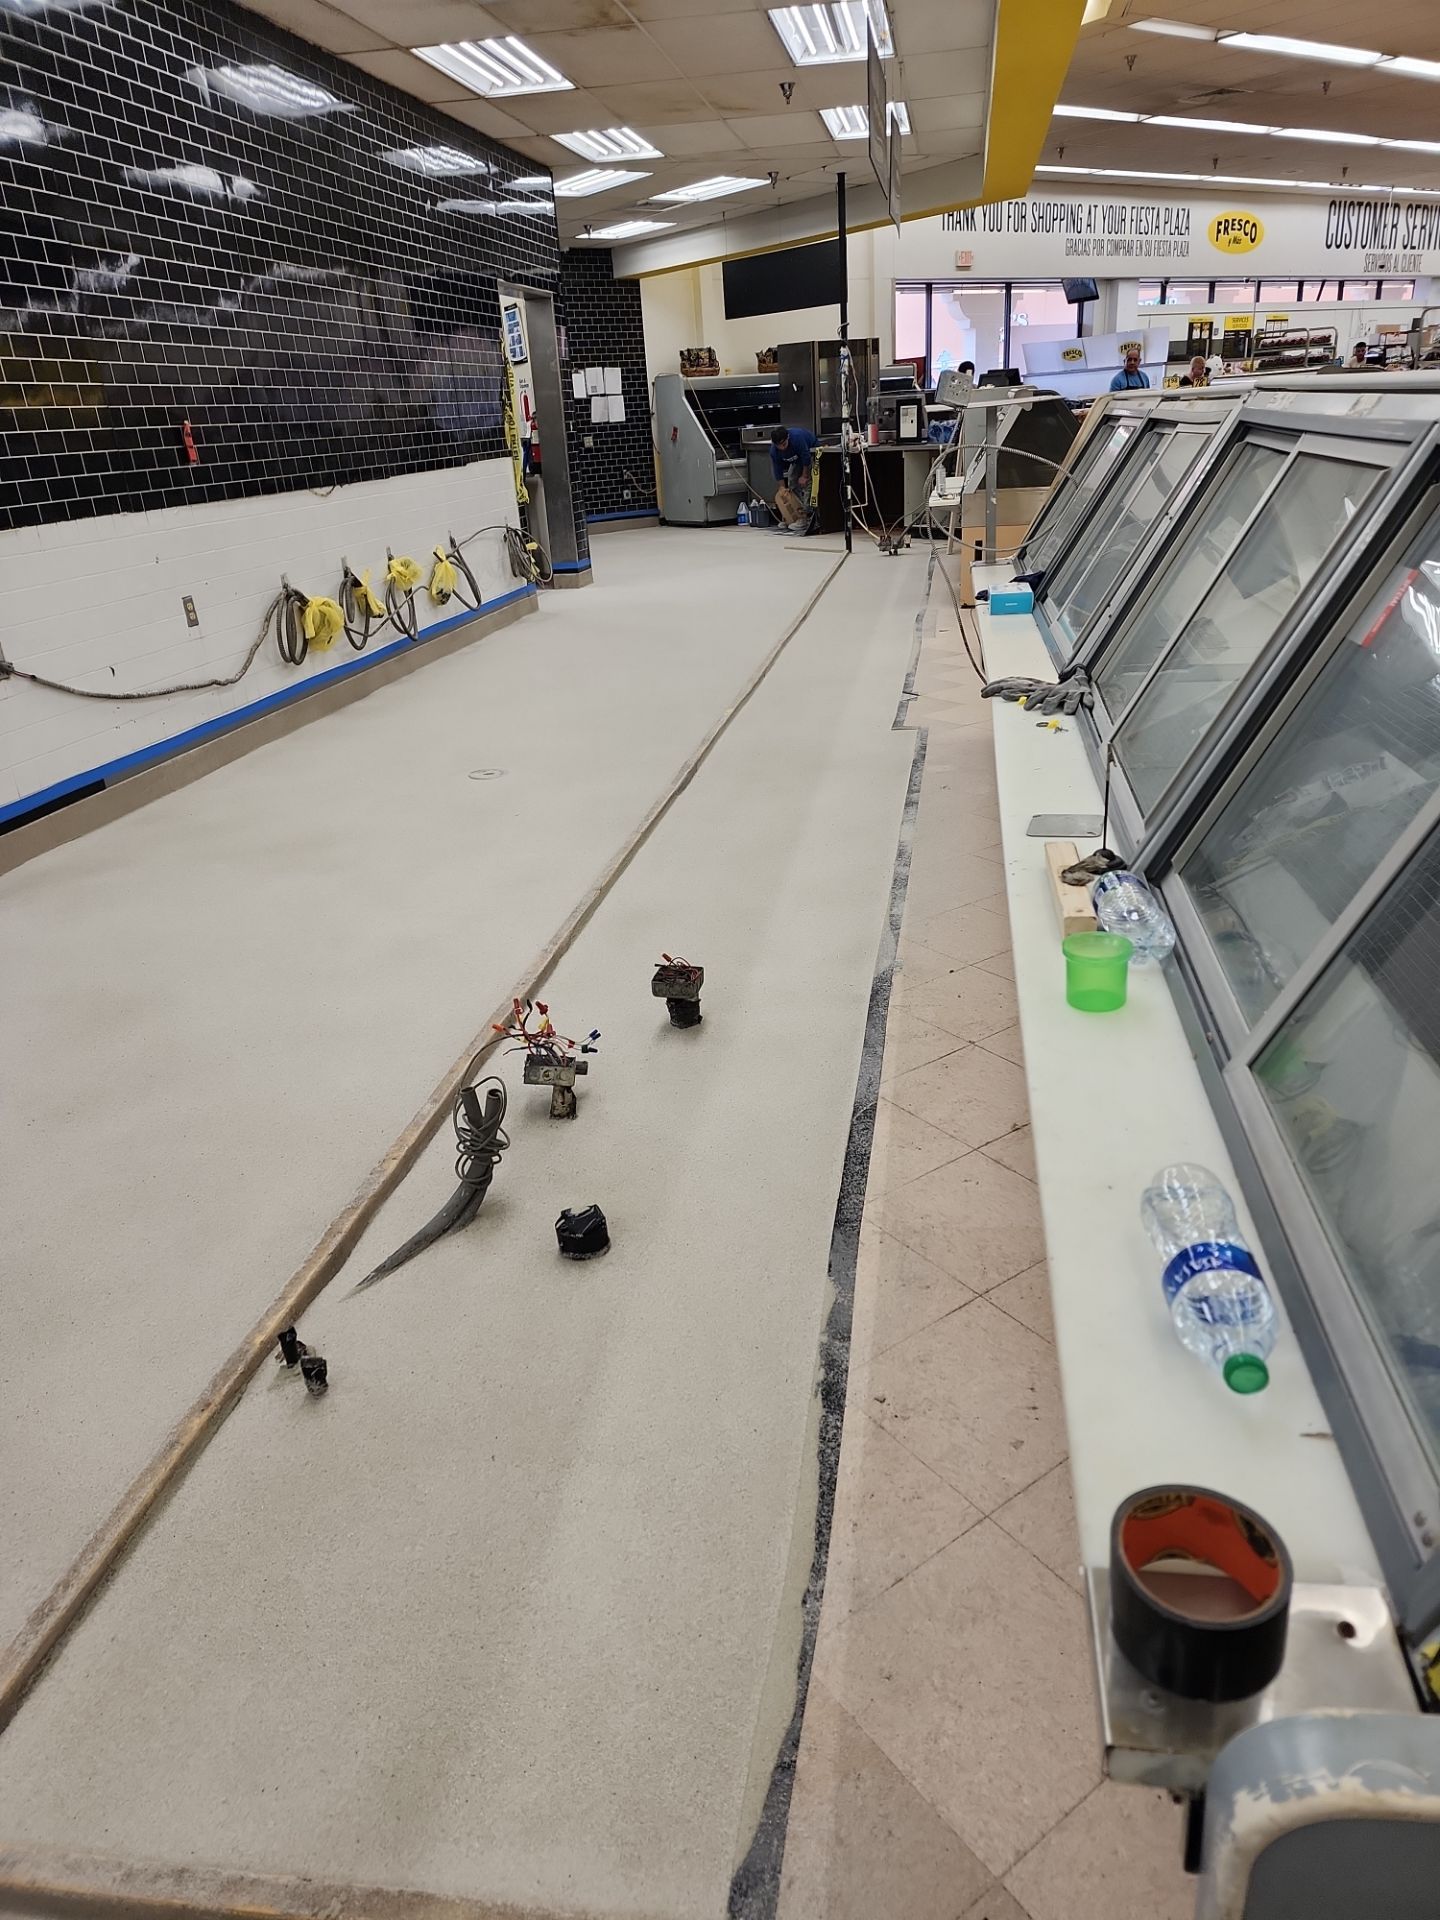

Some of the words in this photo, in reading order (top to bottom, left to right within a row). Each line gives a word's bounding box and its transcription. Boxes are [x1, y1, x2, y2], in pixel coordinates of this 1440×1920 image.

[982, 202, 1003, 232] YOU
[1007, 201, 1027, 232] FOR
[1031, 202, 1083, 234] SHOPPING
[1086, 203, 1098, 234] AT
[1102, 204, 1127, 235] YOUR
[1129, 206, 1160, 235] FIESTA
[1163, 207, 1190, 236] PLAZA
[1215, 218, 1258, 244] FRESCO
[1325, 200, 1400, 250] CUSTOMER
[1402, 203, 1440, 250] SERVI
[1065, 238, 1091, 257] GRACIAS
[1092, 239, 1105, 257] POR
[1106, 239, 1134, 257] COMPRAR
[1135, 239, 1144, 257] EN
[1144, 240, 1153, 257] SU
[1153, 240, 1171, 257] FIESTA
[1172, 240, 1190, 257] PLAZA
